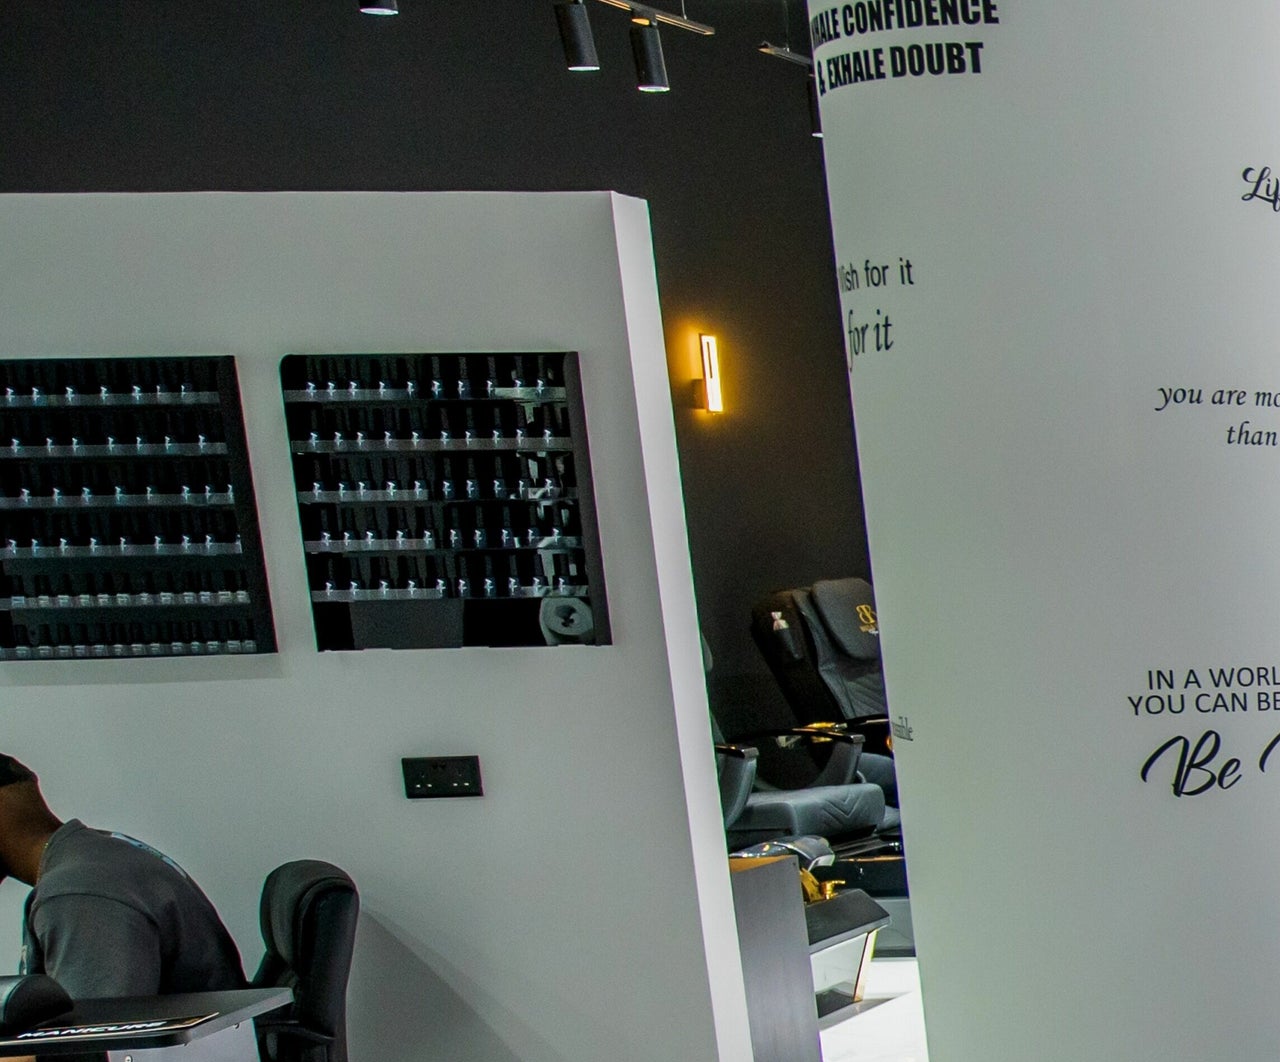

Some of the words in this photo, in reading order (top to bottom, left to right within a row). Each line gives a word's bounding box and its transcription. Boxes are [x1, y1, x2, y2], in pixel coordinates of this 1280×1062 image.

[843, 0, 999, 36] CONFIDENCE
[827, 47, 886, 90] EXHALE
[889, 42, 984, 77] DOUBT
[864, 260, 889, 287] for
[898, 257, 914, 285] it
[847, 309, 868, 373] for
[873, 309, 894, 352] it
[1155, 387, 1203, 411] you
[1211, 388, 1247, 406] are
[1226, 421, 1277, 447] than
[1148, 669, 1174, 690] IN
[1184, 669, 1201, 688] A
[1128, 694, 1184, 716] YOU
[1195, 692, 1248, 713] CAN
[1141, 729, 1243, 798] Be
